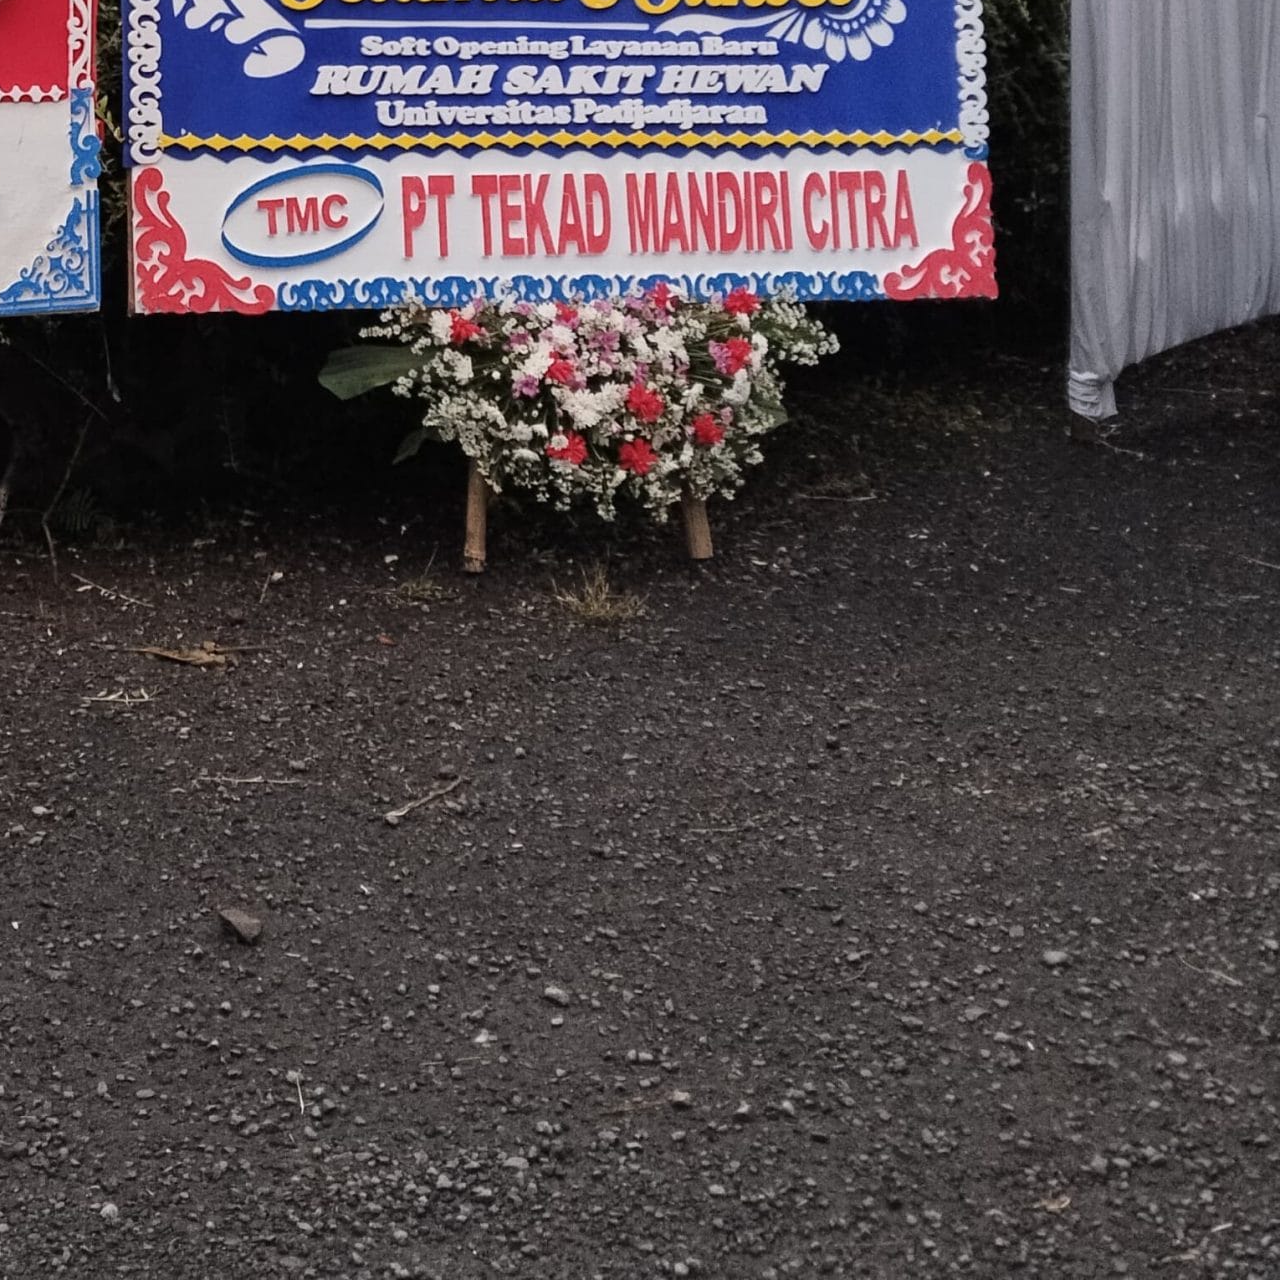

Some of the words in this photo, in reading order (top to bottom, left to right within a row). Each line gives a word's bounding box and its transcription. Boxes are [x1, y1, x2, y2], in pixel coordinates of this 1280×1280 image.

[360, 35, 431, 57] Soft
[433, 36, 569, 60] Opening
[569, 36, 700, 58] Layanan
[700, 37, 779, 57] Baru
[309, 63, 499, 96] RUMAH
[502, 63, 656, 96] SAKIT
[655, 63, 829, 95] HEWAN
[374, 99, 572, 128] Universitas
[572, 98, 768, 130] Padjadjaran
[257, 193, 350, 236] TMC
[401, 174, 456, 259] PT
[471, 171, 611, 257] TEKAD
[625, 169, 793, 255] MANDIRI
[802, 169, 920, 251] CITRA
